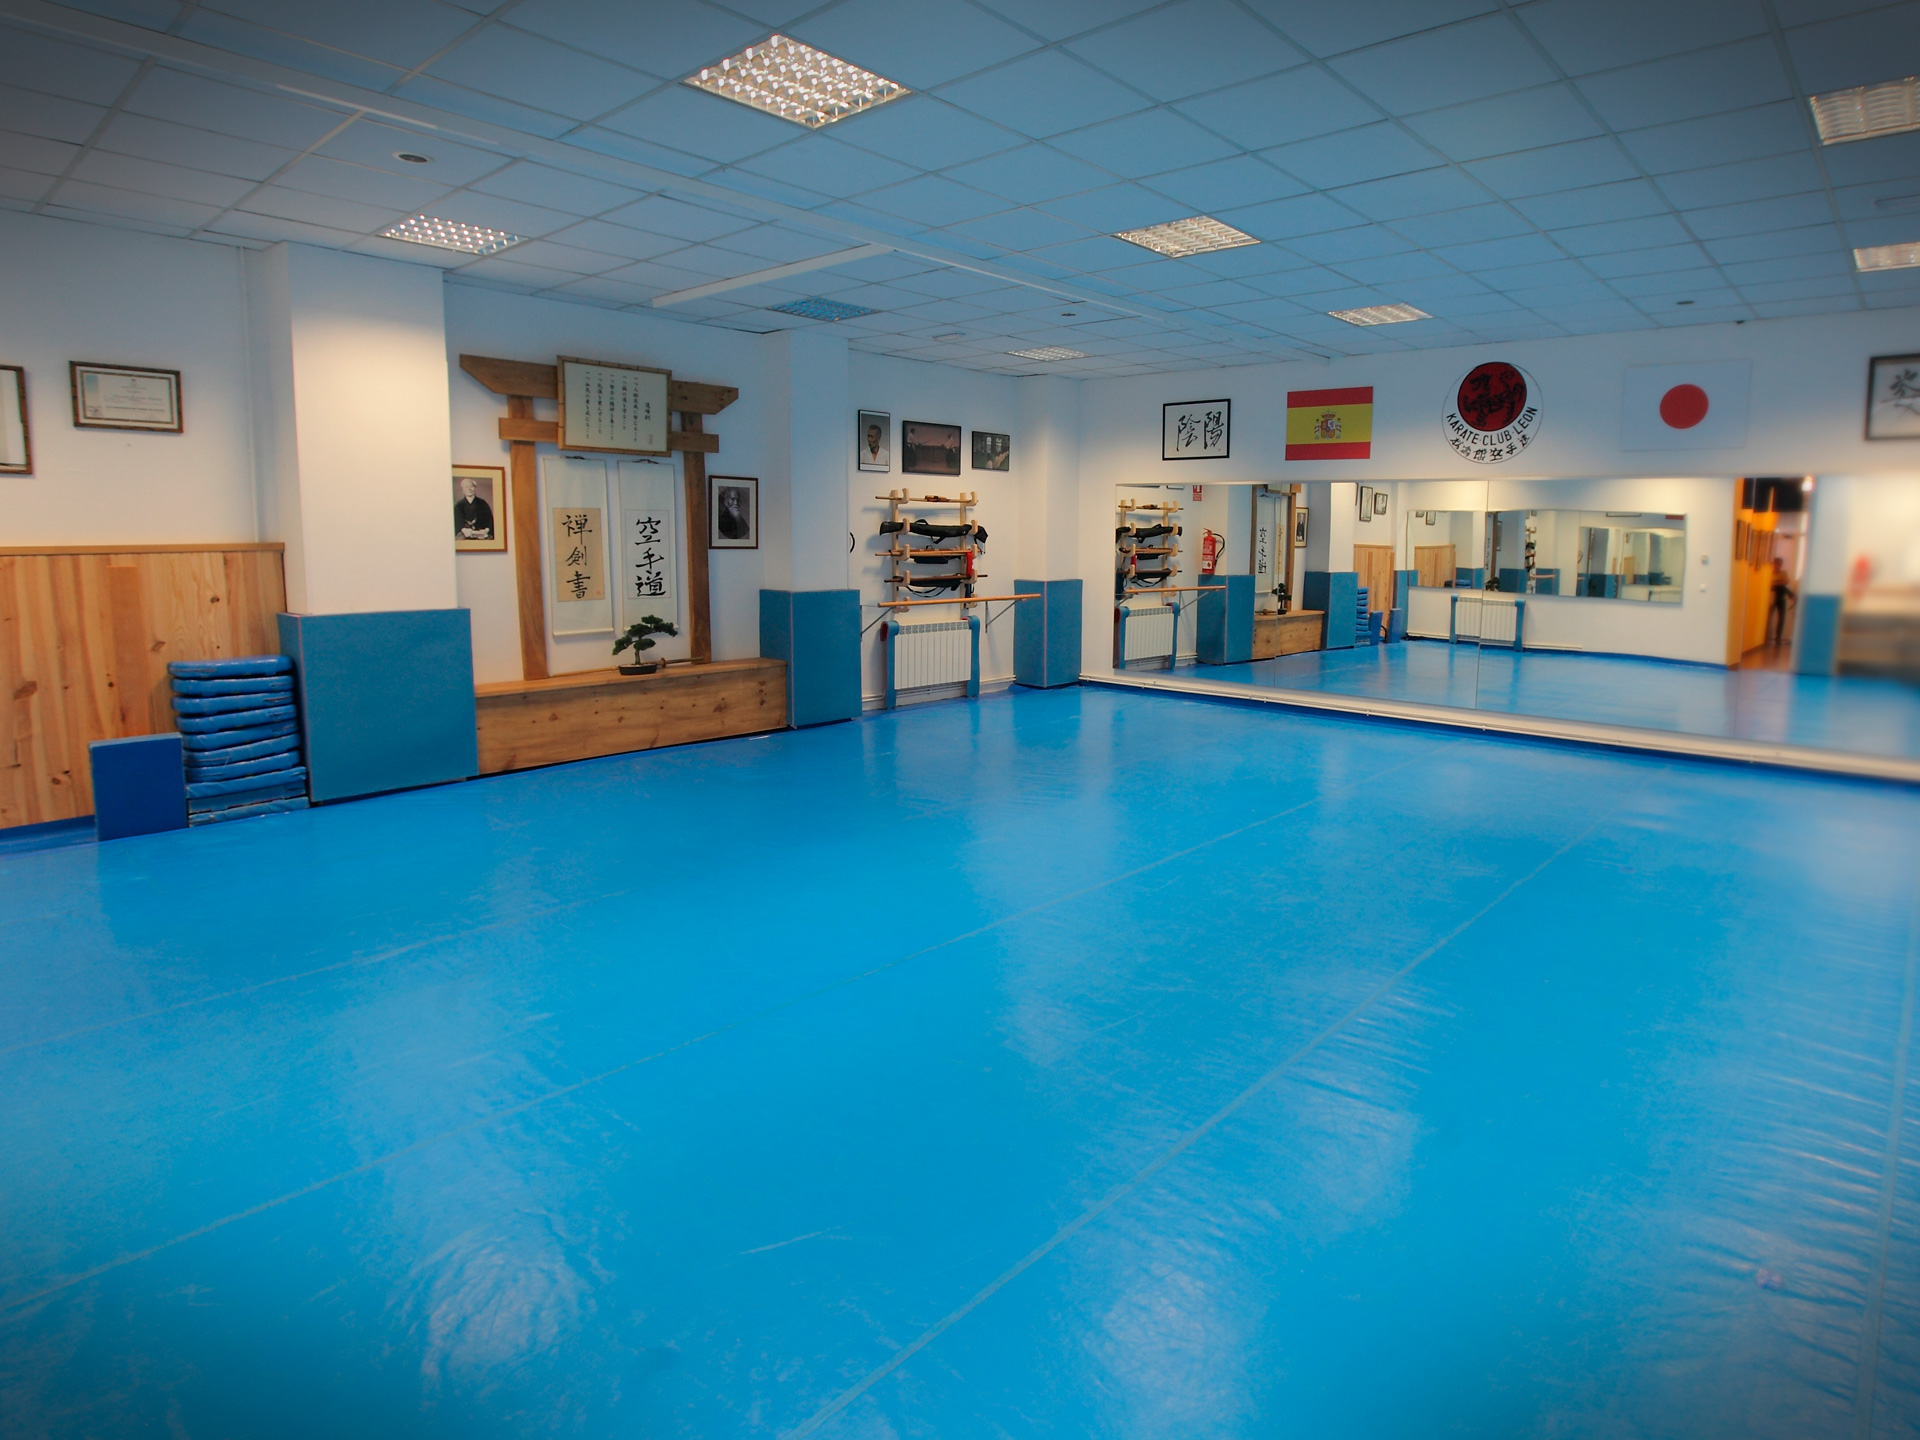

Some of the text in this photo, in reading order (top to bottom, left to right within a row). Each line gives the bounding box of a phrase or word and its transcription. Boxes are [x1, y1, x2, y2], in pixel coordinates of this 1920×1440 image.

[1446, 406, 1538, 446] KARATE CLUB LEON
[635, 516, 666, 597] 空手道
